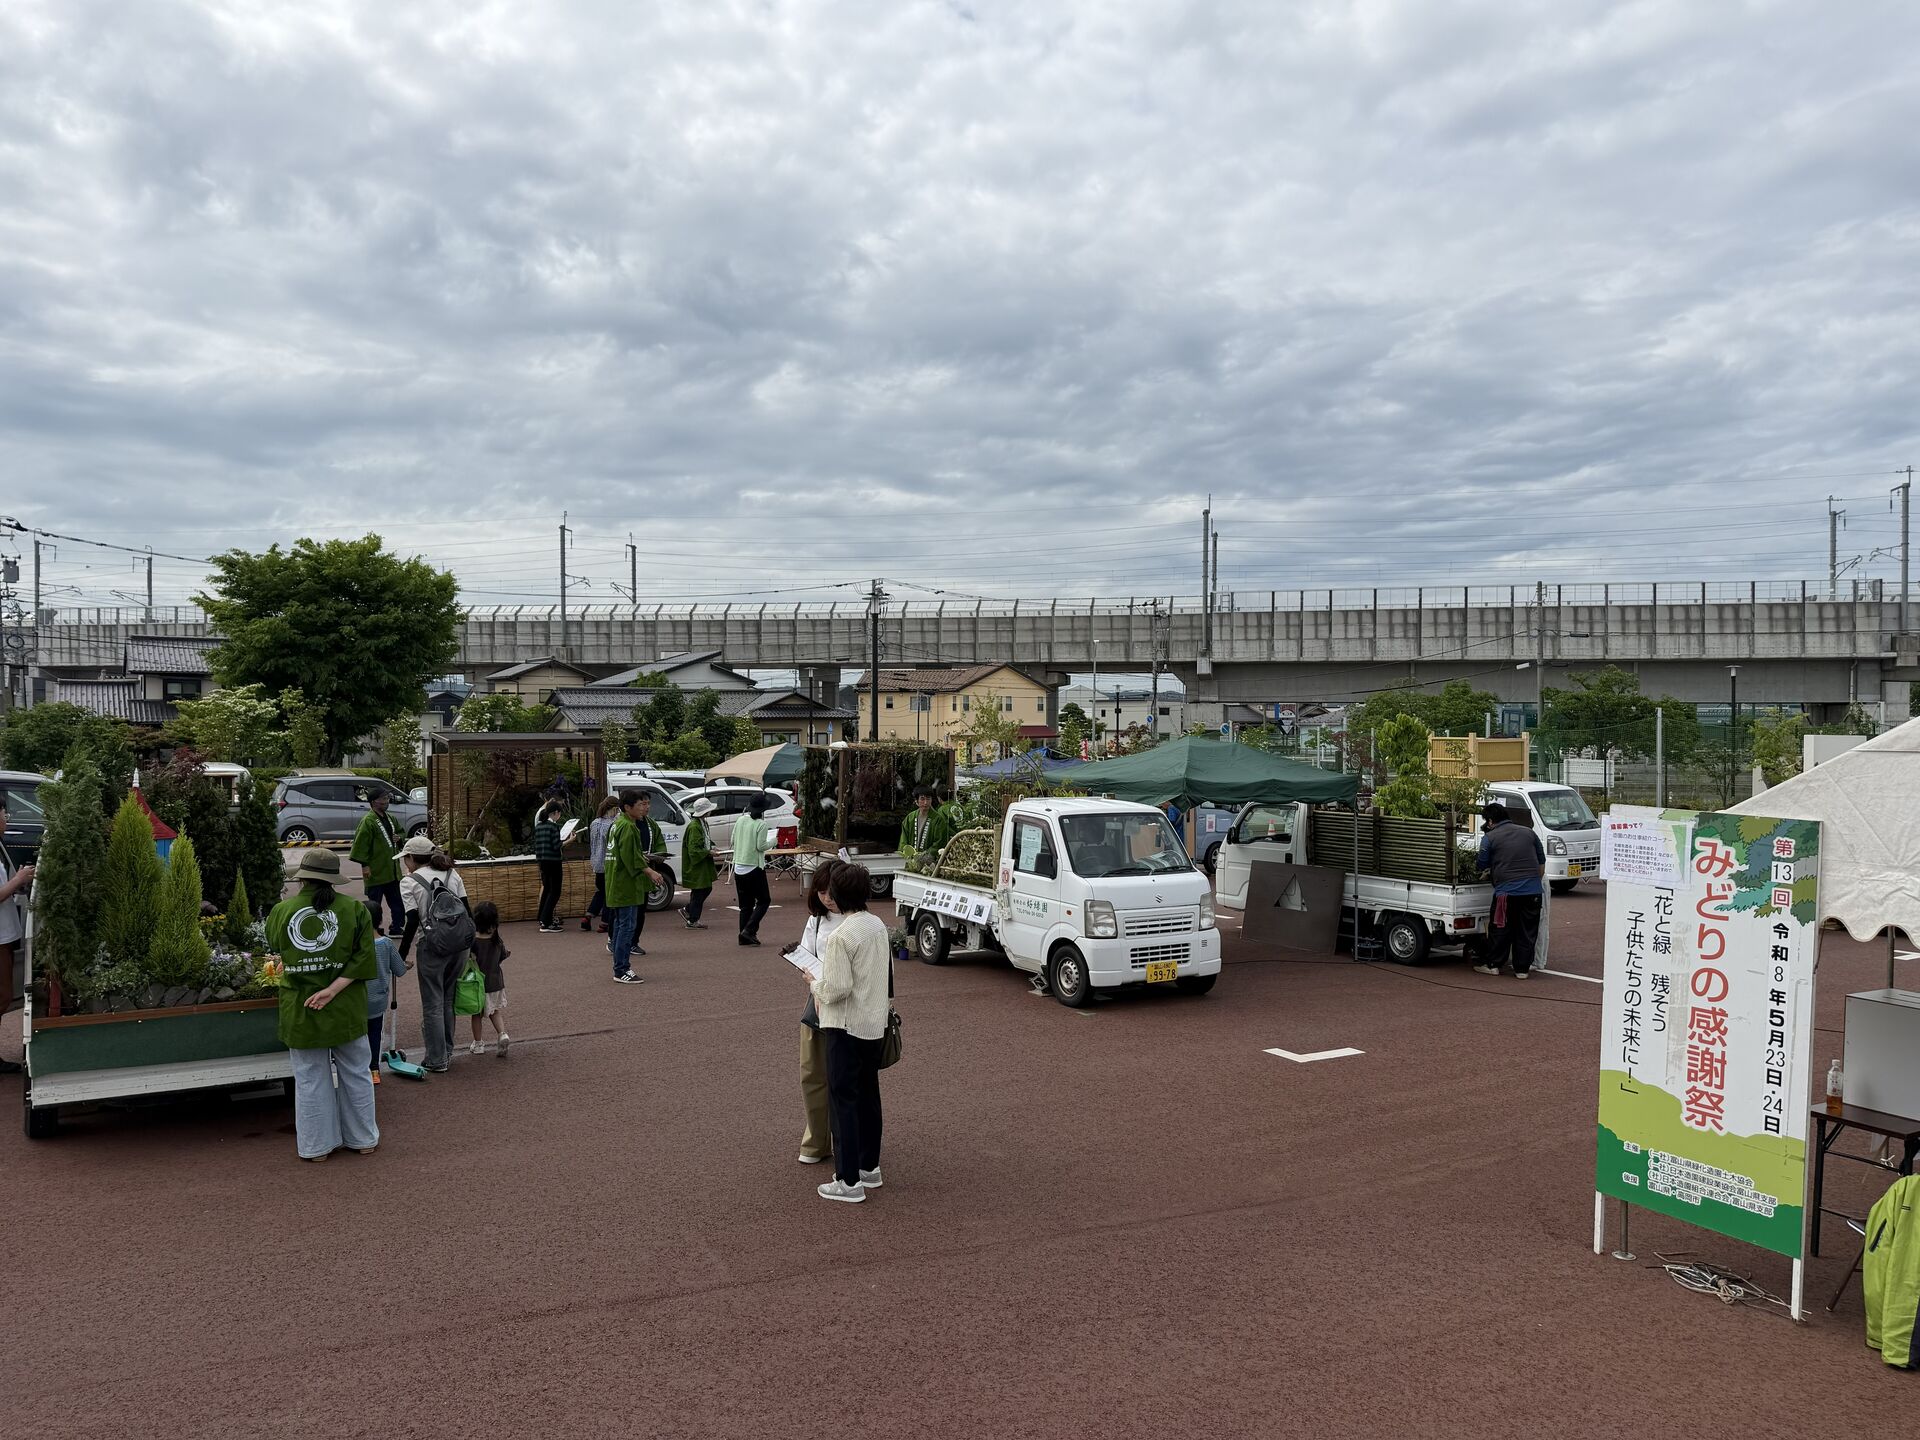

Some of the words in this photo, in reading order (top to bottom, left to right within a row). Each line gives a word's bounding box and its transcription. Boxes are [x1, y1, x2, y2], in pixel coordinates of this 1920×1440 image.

[1773, 838, 1793, 907] 第13回
[1651, 973, 1670, 1032] 残そう
[1684, 840, 1735, 1132] みどりの感謝祭
[1625, 1142, 1639, 1153] 主催
